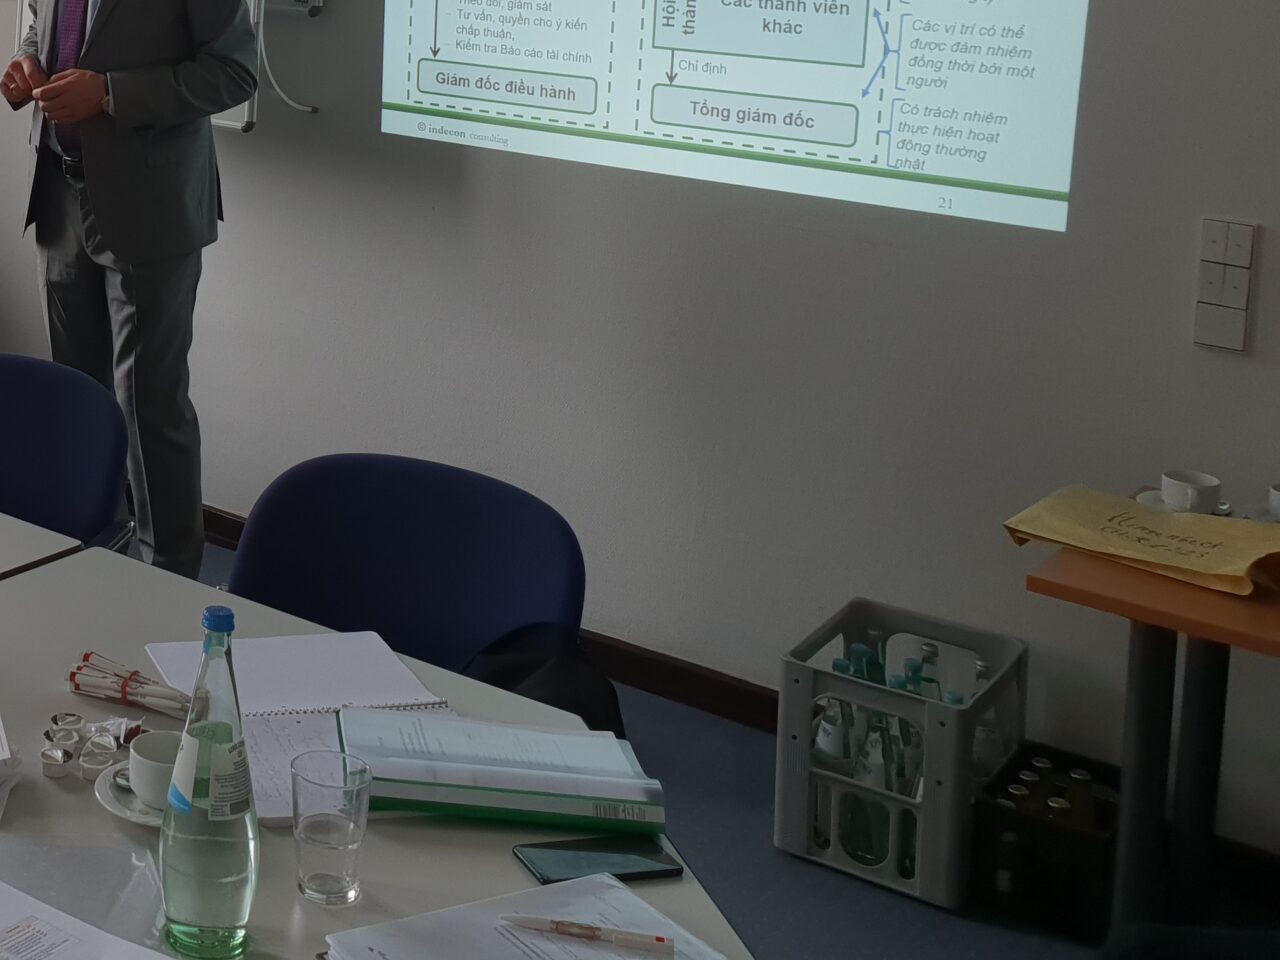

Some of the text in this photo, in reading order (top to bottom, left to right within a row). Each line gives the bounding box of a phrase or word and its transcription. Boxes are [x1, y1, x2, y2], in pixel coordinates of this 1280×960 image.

[662, 0, 680, 28] Hội
[813, 1, 850, 16] viên
[533, 16, 552, 28] cho
[762, 18, 803, 34] khác
[912, 19, 940, 33] Các
[435, 72, 576, 101] Giám đốc điều hành
[690, 99, 815, 128] Tổng giám đốc
[428, 123, 466, 139] indecon
[469, 132, 509, 146] consulting
[938, 197, 953, 210] 21
